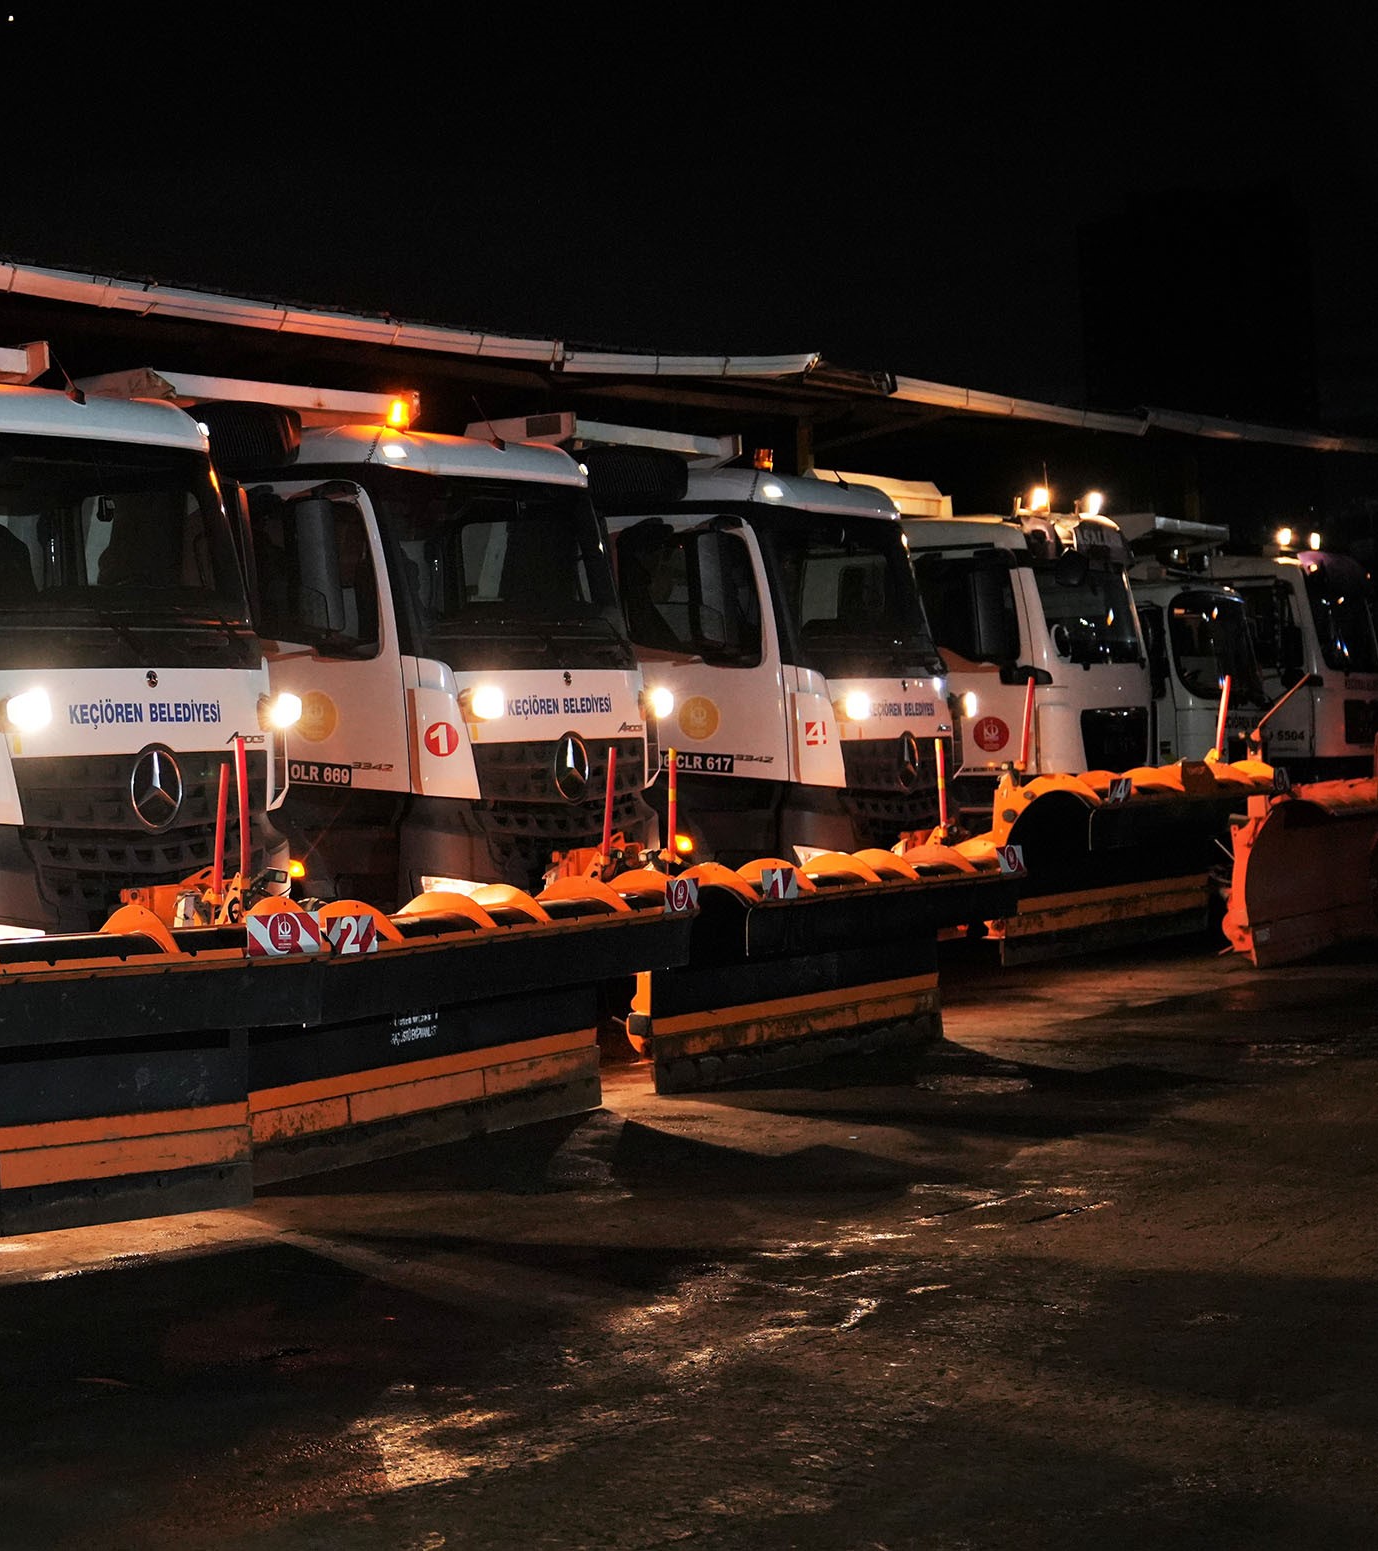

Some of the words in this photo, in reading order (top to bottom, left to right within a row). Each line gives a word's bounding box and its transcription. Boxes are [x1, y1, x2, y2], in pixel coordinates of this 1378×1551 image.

[69, 699, 143, 729] KEÇİÖREN
[150, 699, 221, 723] BELEDİYESİ
[508, 695, 560, 720] KEÇİÖREN
[563, 693, 612, 713] BELEDİYESİ
[226, 731, 265, 744] AOCS
[429, 724, 449, 754] 1
[806, 721, 827, 745] 4
[351, 762, 394, 772] 3342
[676, 755, 702, 770] CLR
[706, 756, 731, 771] 617
[771, 869, 784, 899] 1
[340, 916, 361, 955] 2
